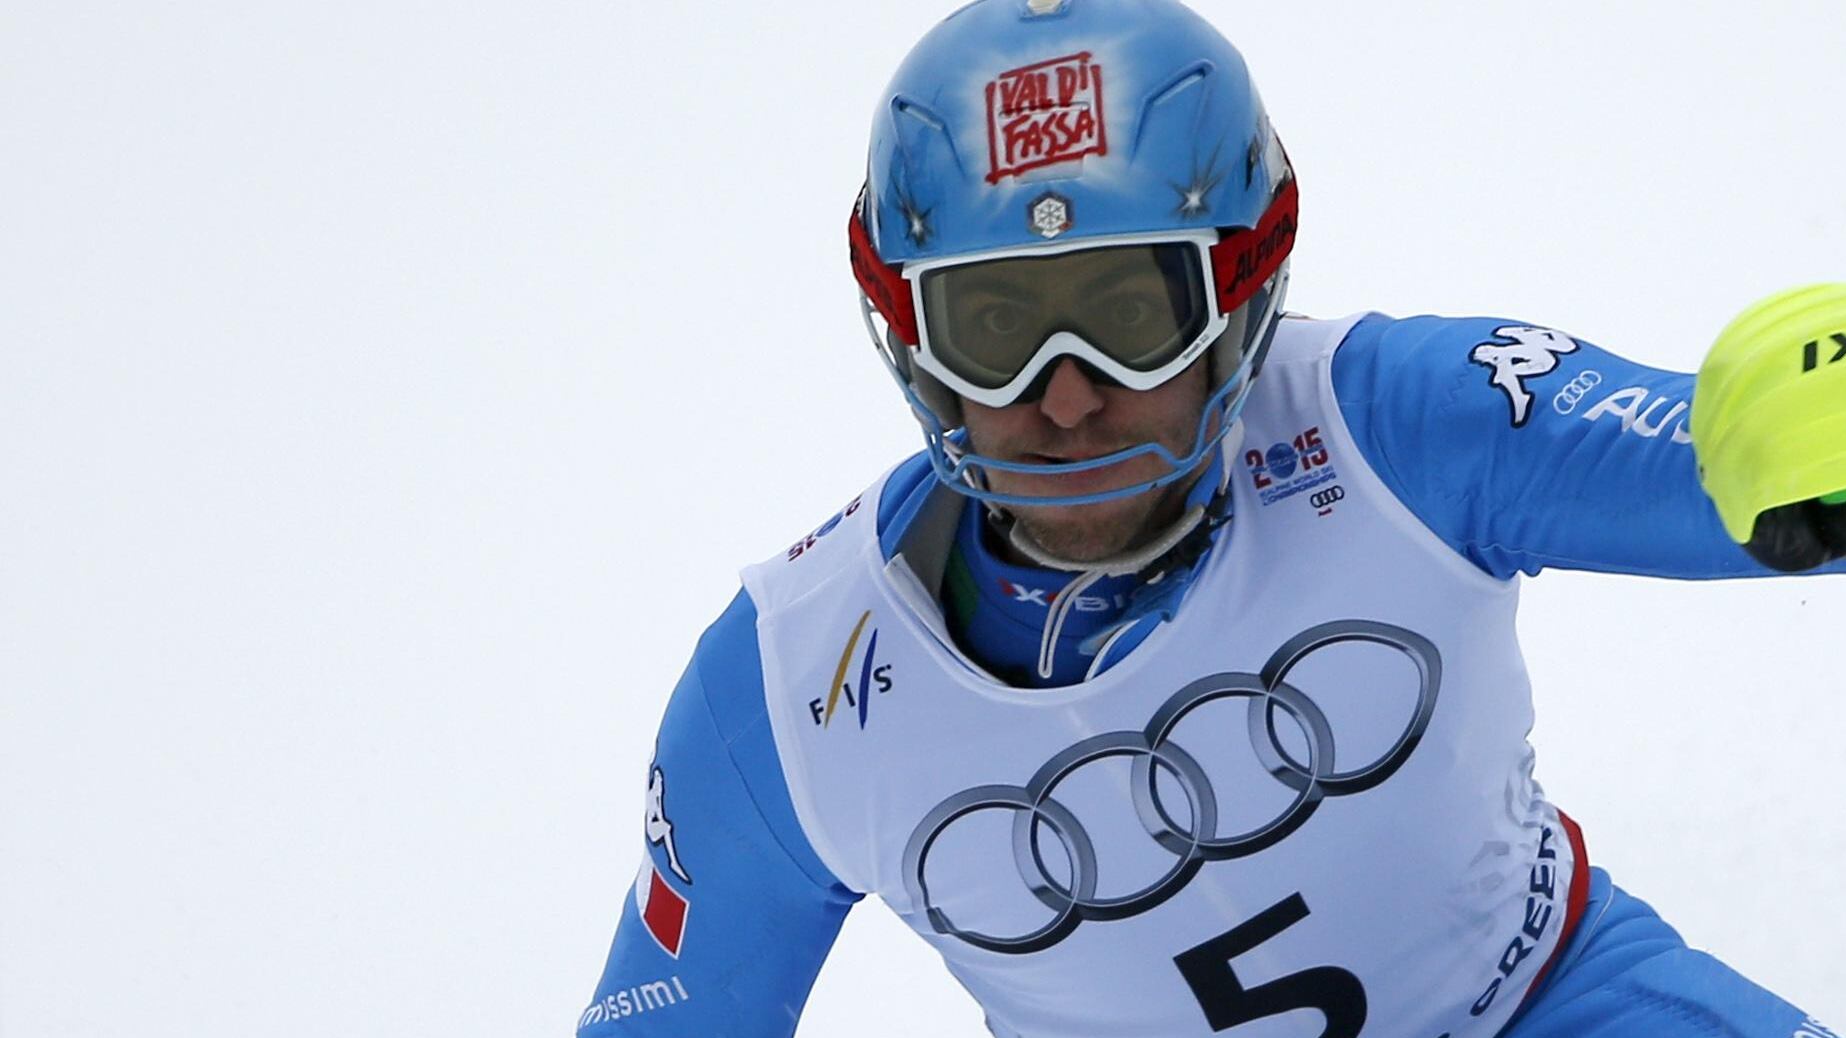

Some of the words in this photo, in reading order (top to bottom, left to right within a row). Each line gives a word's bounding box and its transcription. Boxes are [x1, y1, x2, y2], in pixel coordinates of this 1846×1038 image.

[1003, 109, 1094, 165] FASSA
[1224, 213, 1294, 294] ALPINA
[1245, 426, 1329, 490] 2015
[809, 664, 892, 725] FIS
